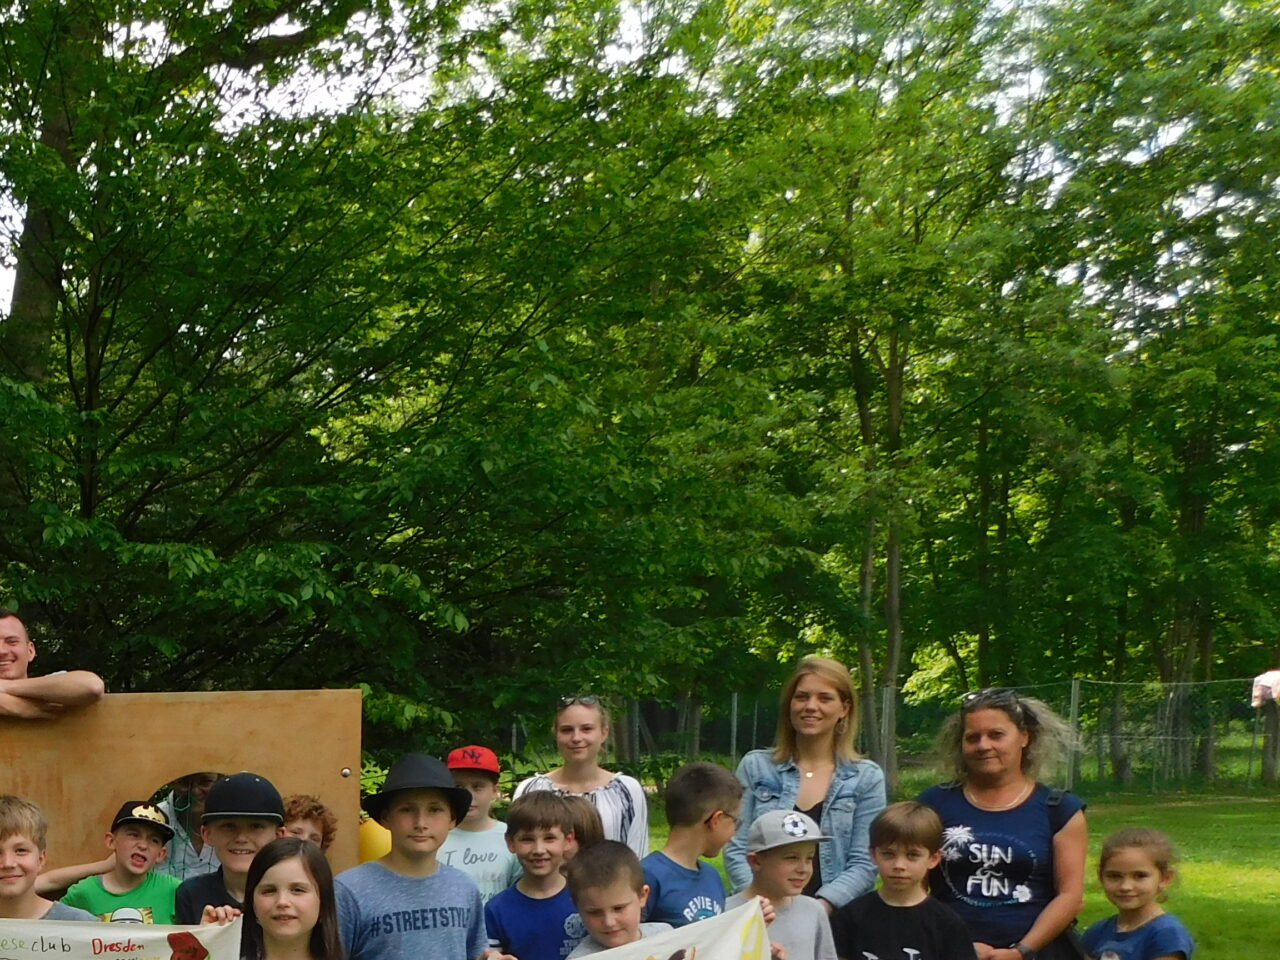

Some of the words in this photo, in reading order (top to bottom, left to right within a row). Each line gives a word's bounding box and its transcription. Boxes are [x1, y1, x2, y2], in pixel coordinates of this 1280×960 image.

[463, 847, 498, 865] love
[968, 843, 1013, 865] SUN
[966, 875, 1009, 897] FUN
[91, 937, 145, 956] Dresden
